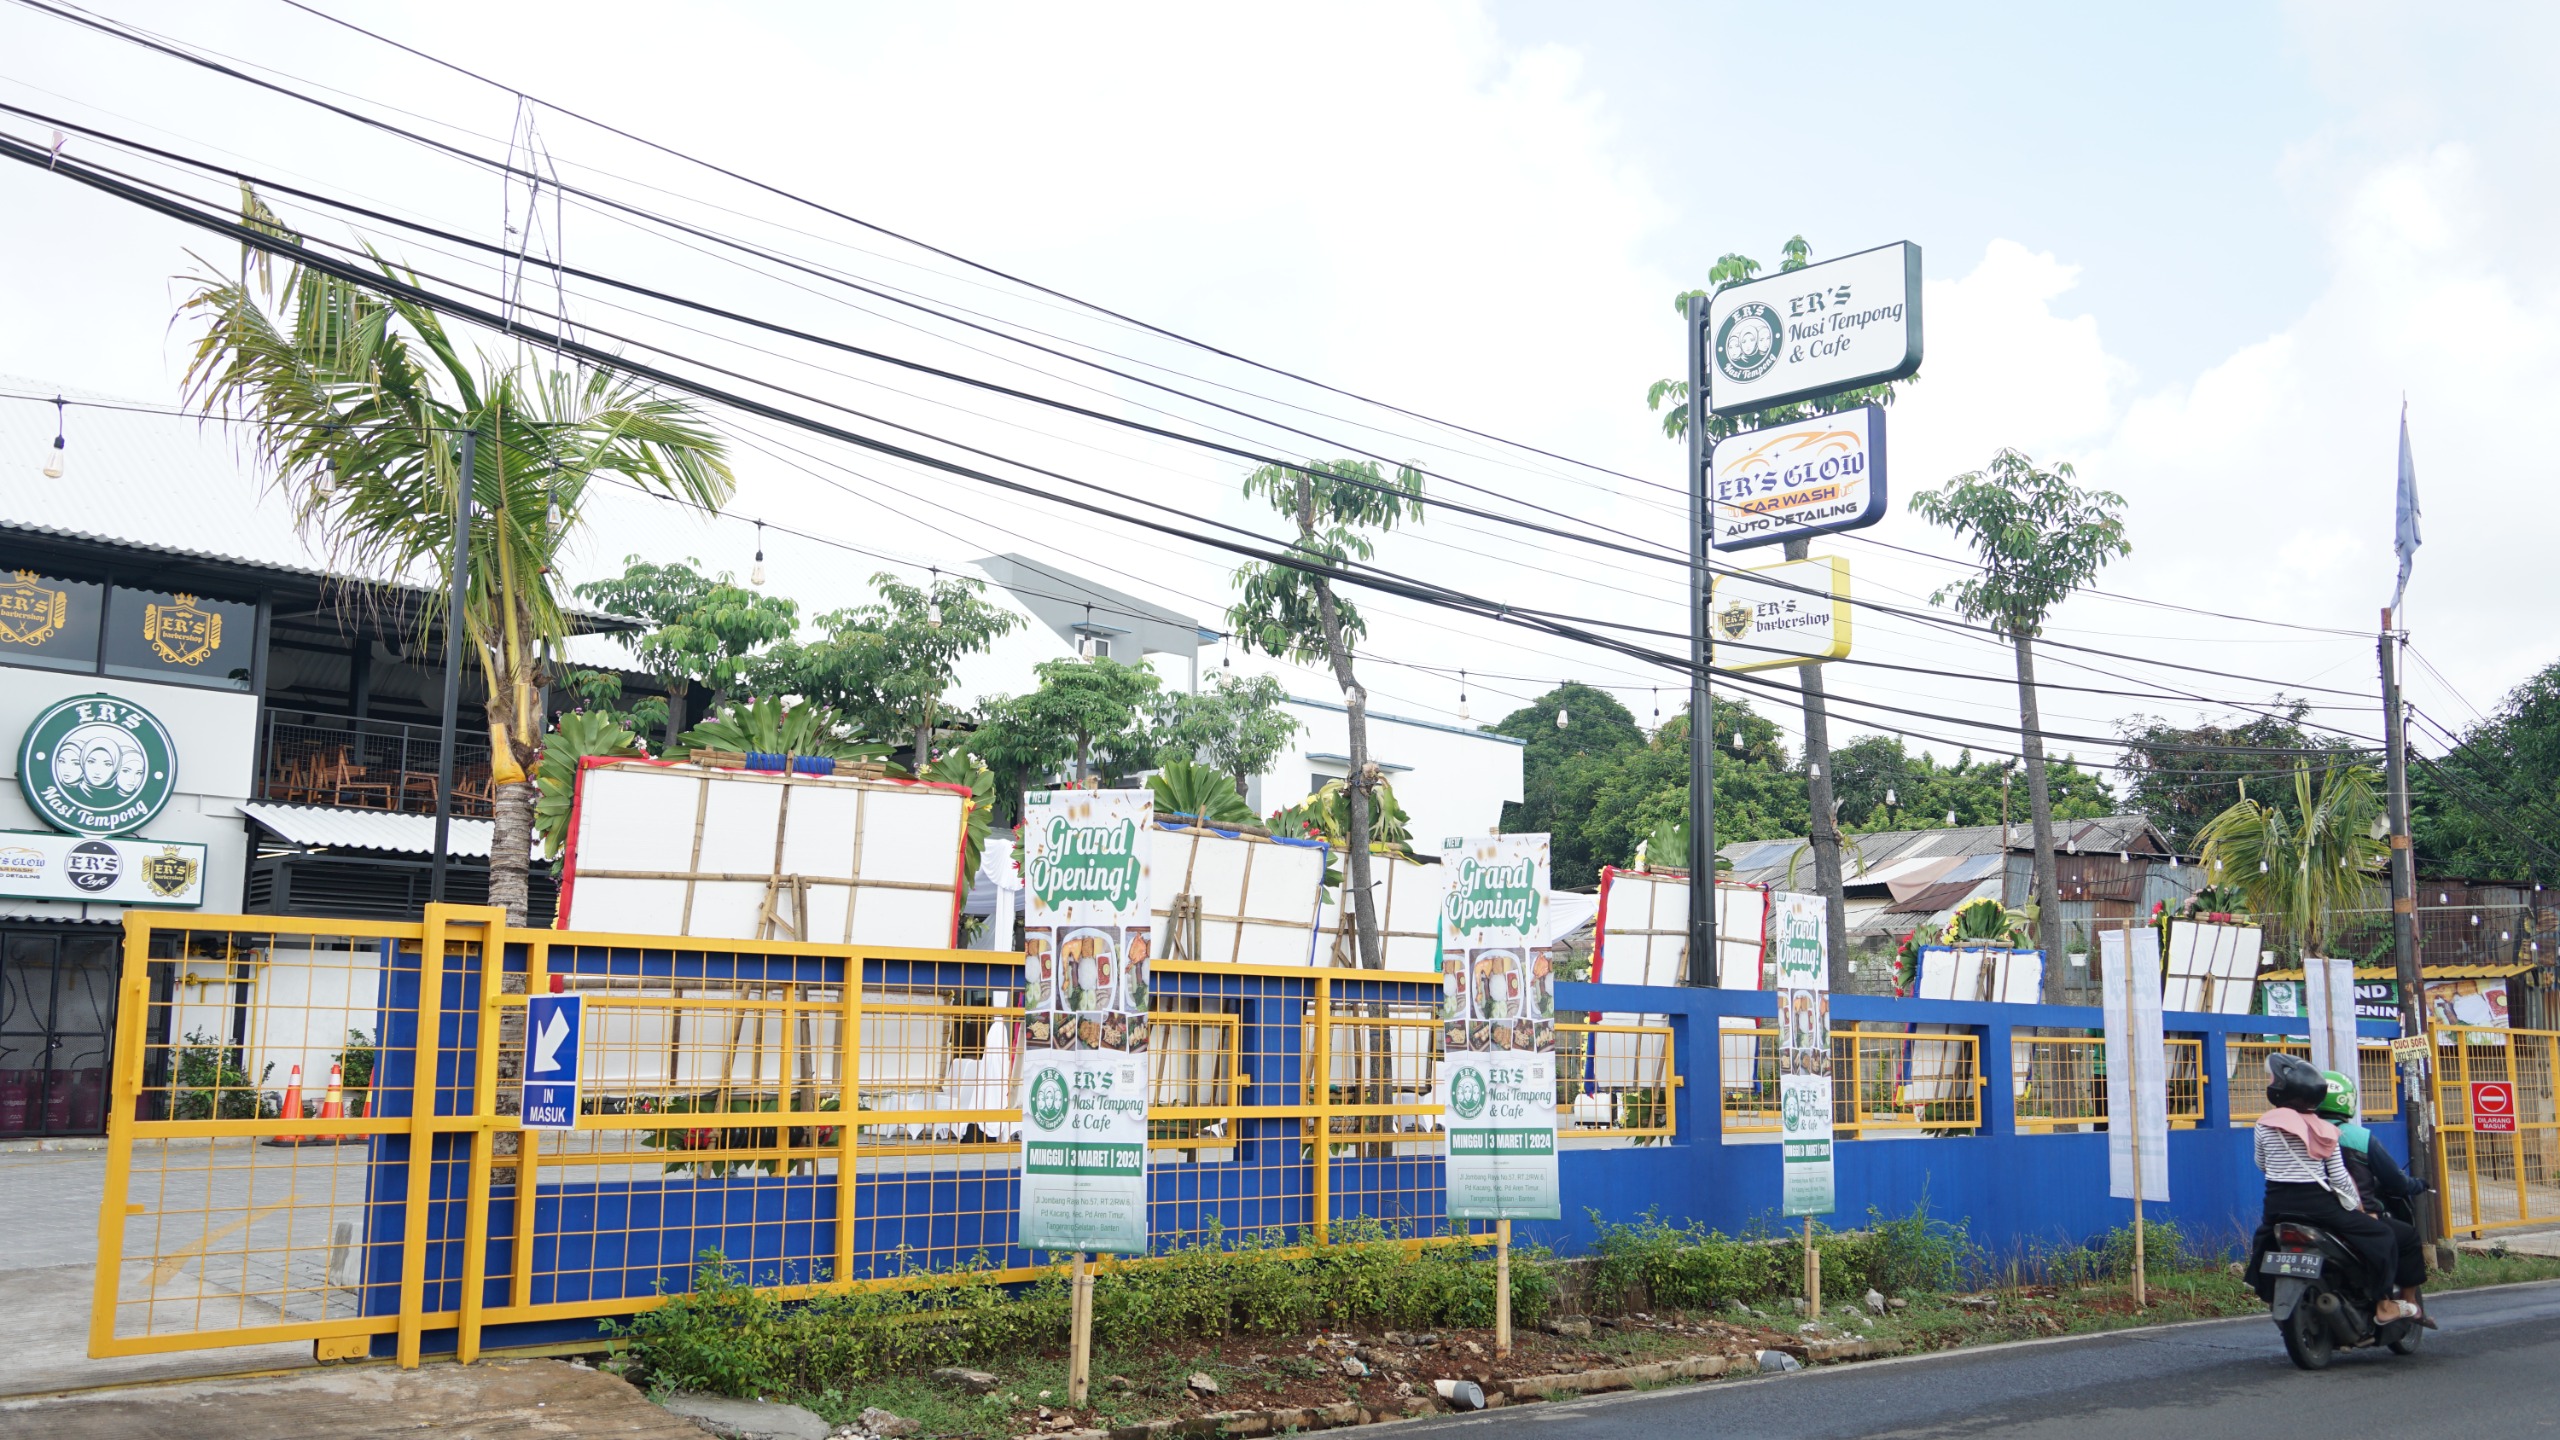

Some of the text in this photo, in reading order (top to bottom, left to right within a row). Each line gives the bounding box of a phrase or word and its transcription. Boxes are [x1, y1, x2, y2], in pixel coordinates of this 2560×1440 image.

[1789, 283, 1851, 318] ER'S
[1732, 305, 1766, 323] ER'S
[1788, 304, 1903, 342] Nasi Tempong
[1789, 334, 1851, 364] & Cafe
[1724, 354, 1776, 380] Nasi Tempong
[1718, 451, 1864, 501] ER'S GLOW
[1743, 487, 1836, 514] CAR WASH
[1727, 502, 1857, 536] AUTO DETAILING
[0, 594, 48, 613] ER'S
[1757, 600, 1796, 617] ER'S
[1, 609, 45, 622] barbershop
[1756, 613, 1829, 632] barbershop
[162, 617, 206, 635] ER'S
[162, 631, 203, 643] barbershop
[76, 703, 144, 730] ER'S
[41, 785, 149, 829] Nasi Tempong
[1032, 792, 1049, 804] NEW
[1047, 817, 1129, 865] Grand
[1446, 838, 1461, 849] NEW
[69, 856, 118, 871] ER'S
[154, 864, 186, 875] ER'S
[77, 874, 108, 888] Cafe
[1033, 857, 1133, 901] Opening!
[1459, 858, 1529, 898] Grand
[1449, 890, 1534, 927] Opening!
[1785, 911, 1817, 945] Grand
[1780, 940, 1819, 972] Opening!
[2394, 1037, 2427, 1050] CUCI SOFA
[1041, 1069, 1059, 1080] ER'S
[1073, 1071, 1113, 1089] ER'S
[1489, 1068, 1523, 1084] ER'S
[544, 1088, 553, 1103] IN
[1489, 1088, 1552, 1104] Nasi Tempong
[530, 1106, 566, 1122] MASUK
[1073, 1095, 1144, 1115] Nasi Tempong
[1490, 1104, 1523, 1119] & Cafe
[1072, 1114, 1111, 1132] & Cafe
[1452, 1134, 1483, 1148] MINGGU
[1490, 1134, 1495, 1148] 3
[1496, 1134, 1523, 1148] MARET
[1530, 1134, 1551, 1148] 2024
[1030, 1148, 1063, 1166] MINGGU
[1071, 1150, 1076, 1166] 3
[1077, 1150, 1109, 1167] MARET
[1116, 1151, 1140, 1168] 2024
